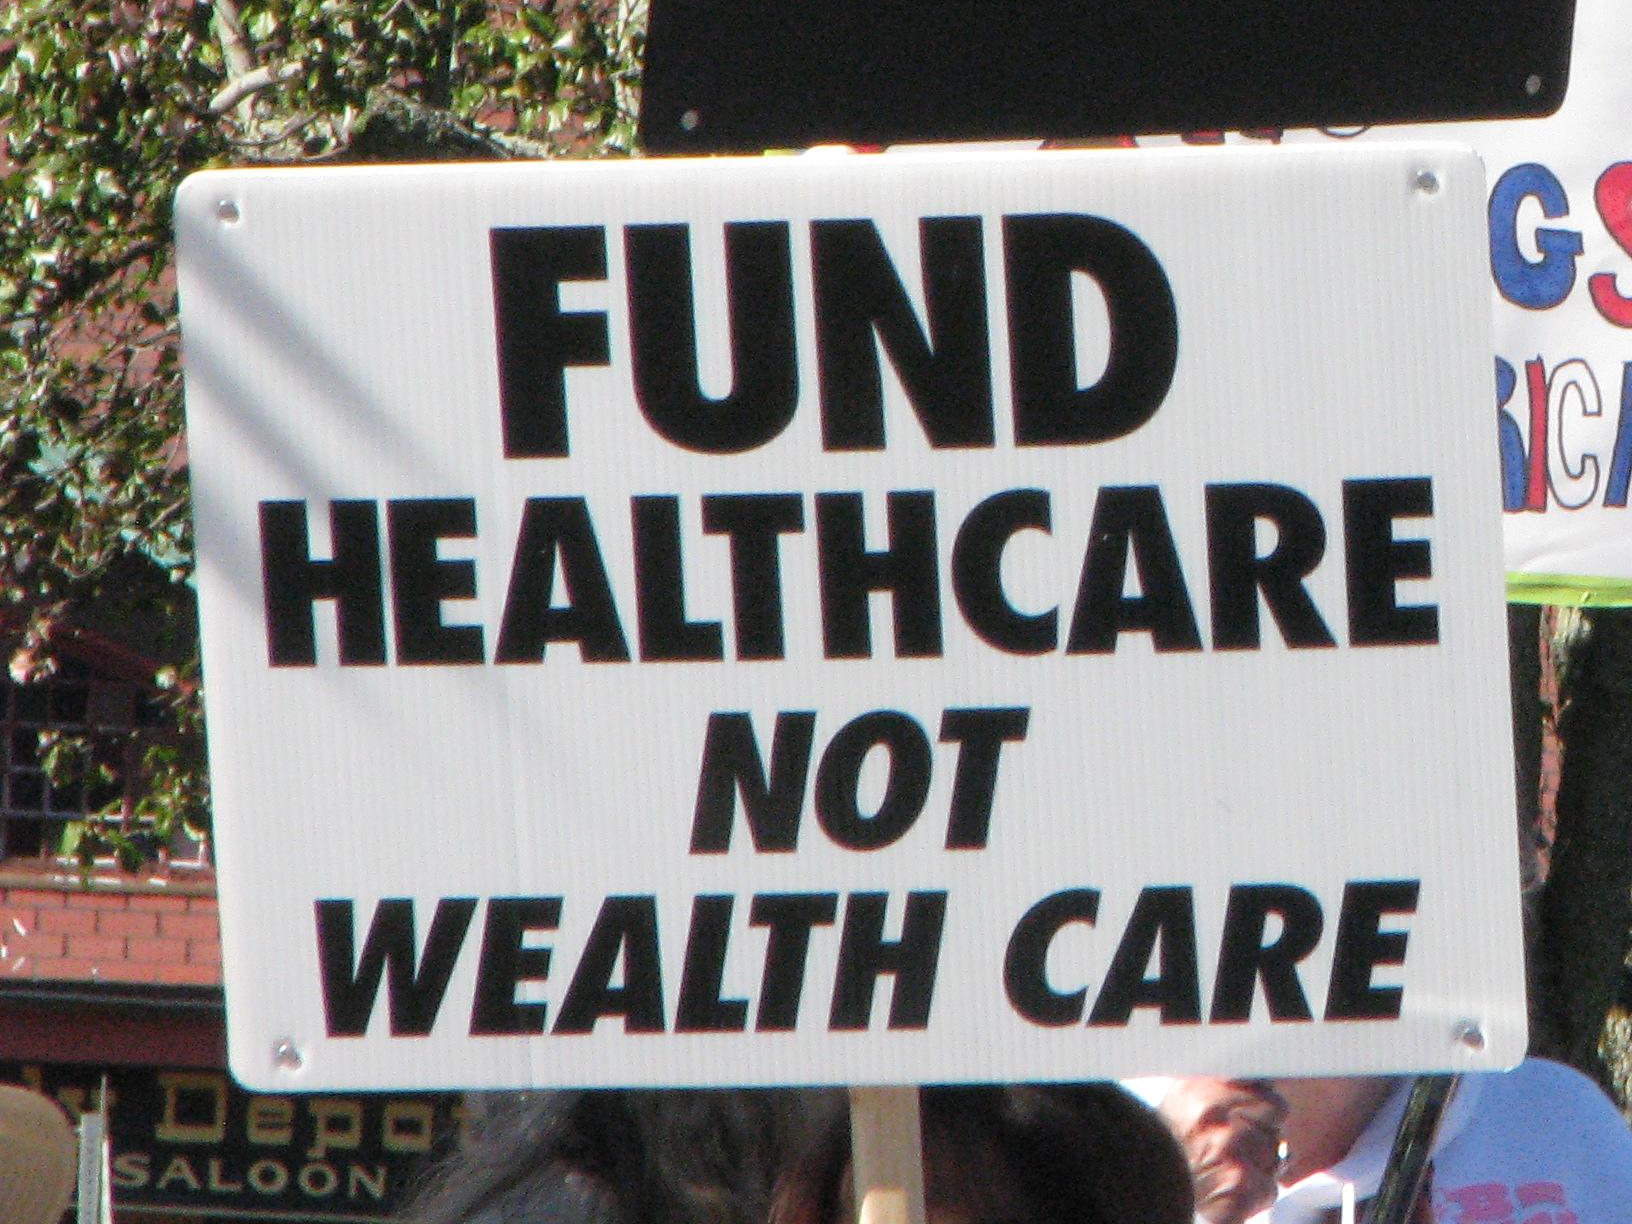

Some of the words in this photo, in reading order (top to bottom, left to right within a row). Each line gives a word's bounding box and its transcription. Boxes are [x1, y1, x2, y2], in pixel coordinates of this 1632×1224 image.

[490, 213, 1178, 458] FUND
[259, 478, 1439, 667] HEALTHCARE
[691, 708, 1029, 854] NOT
[316, 891, 947, 1037] WEALTH
[1004, 880, 1419, 1026] CARE
[111, 1151, 388, 1200] SALOON
[154, 1072, 470, 1158] Depo
